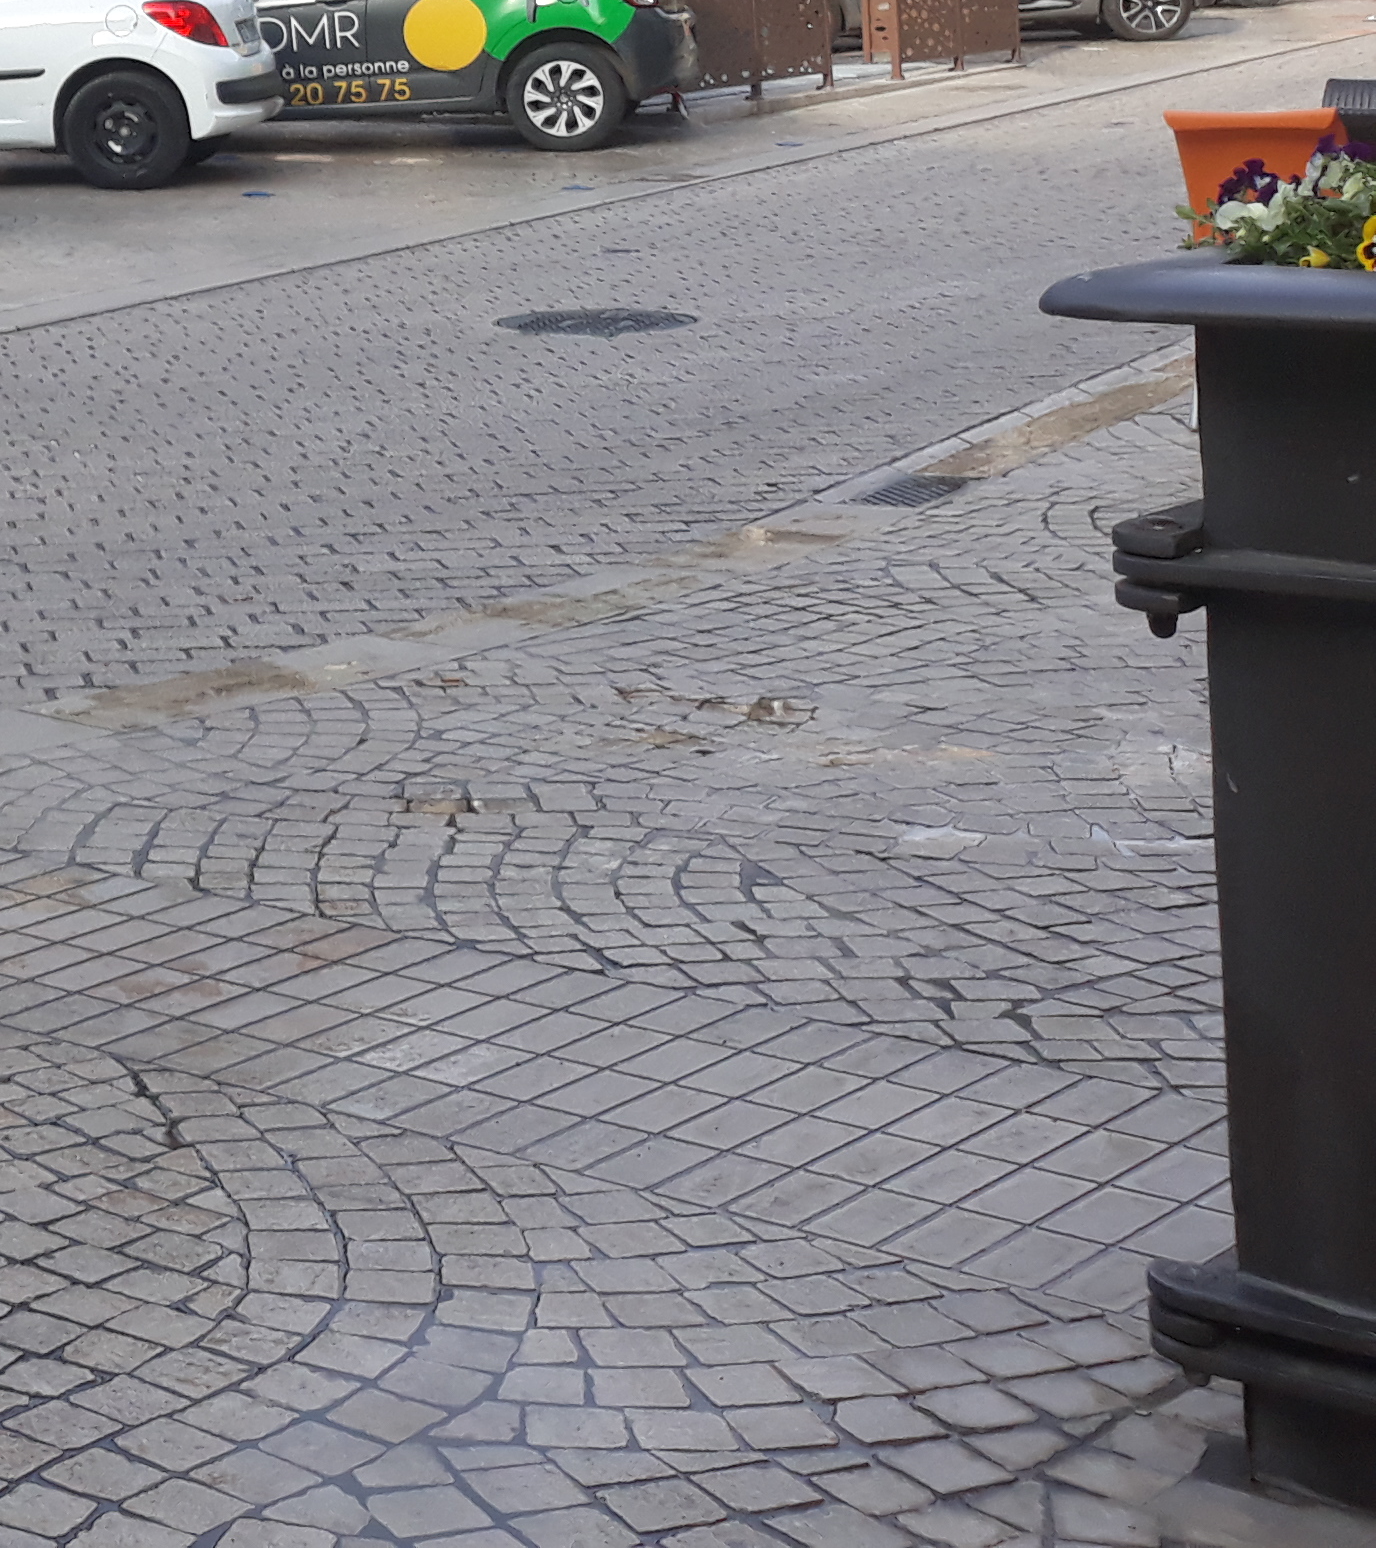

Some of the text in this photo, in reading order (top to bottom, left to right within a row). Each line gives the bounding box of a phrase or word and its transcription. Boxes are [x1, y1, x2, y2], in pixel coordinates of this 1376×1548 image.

[282, 60, 410, 80] à la personne
[289, 78, 412, 105] 20 75 75
